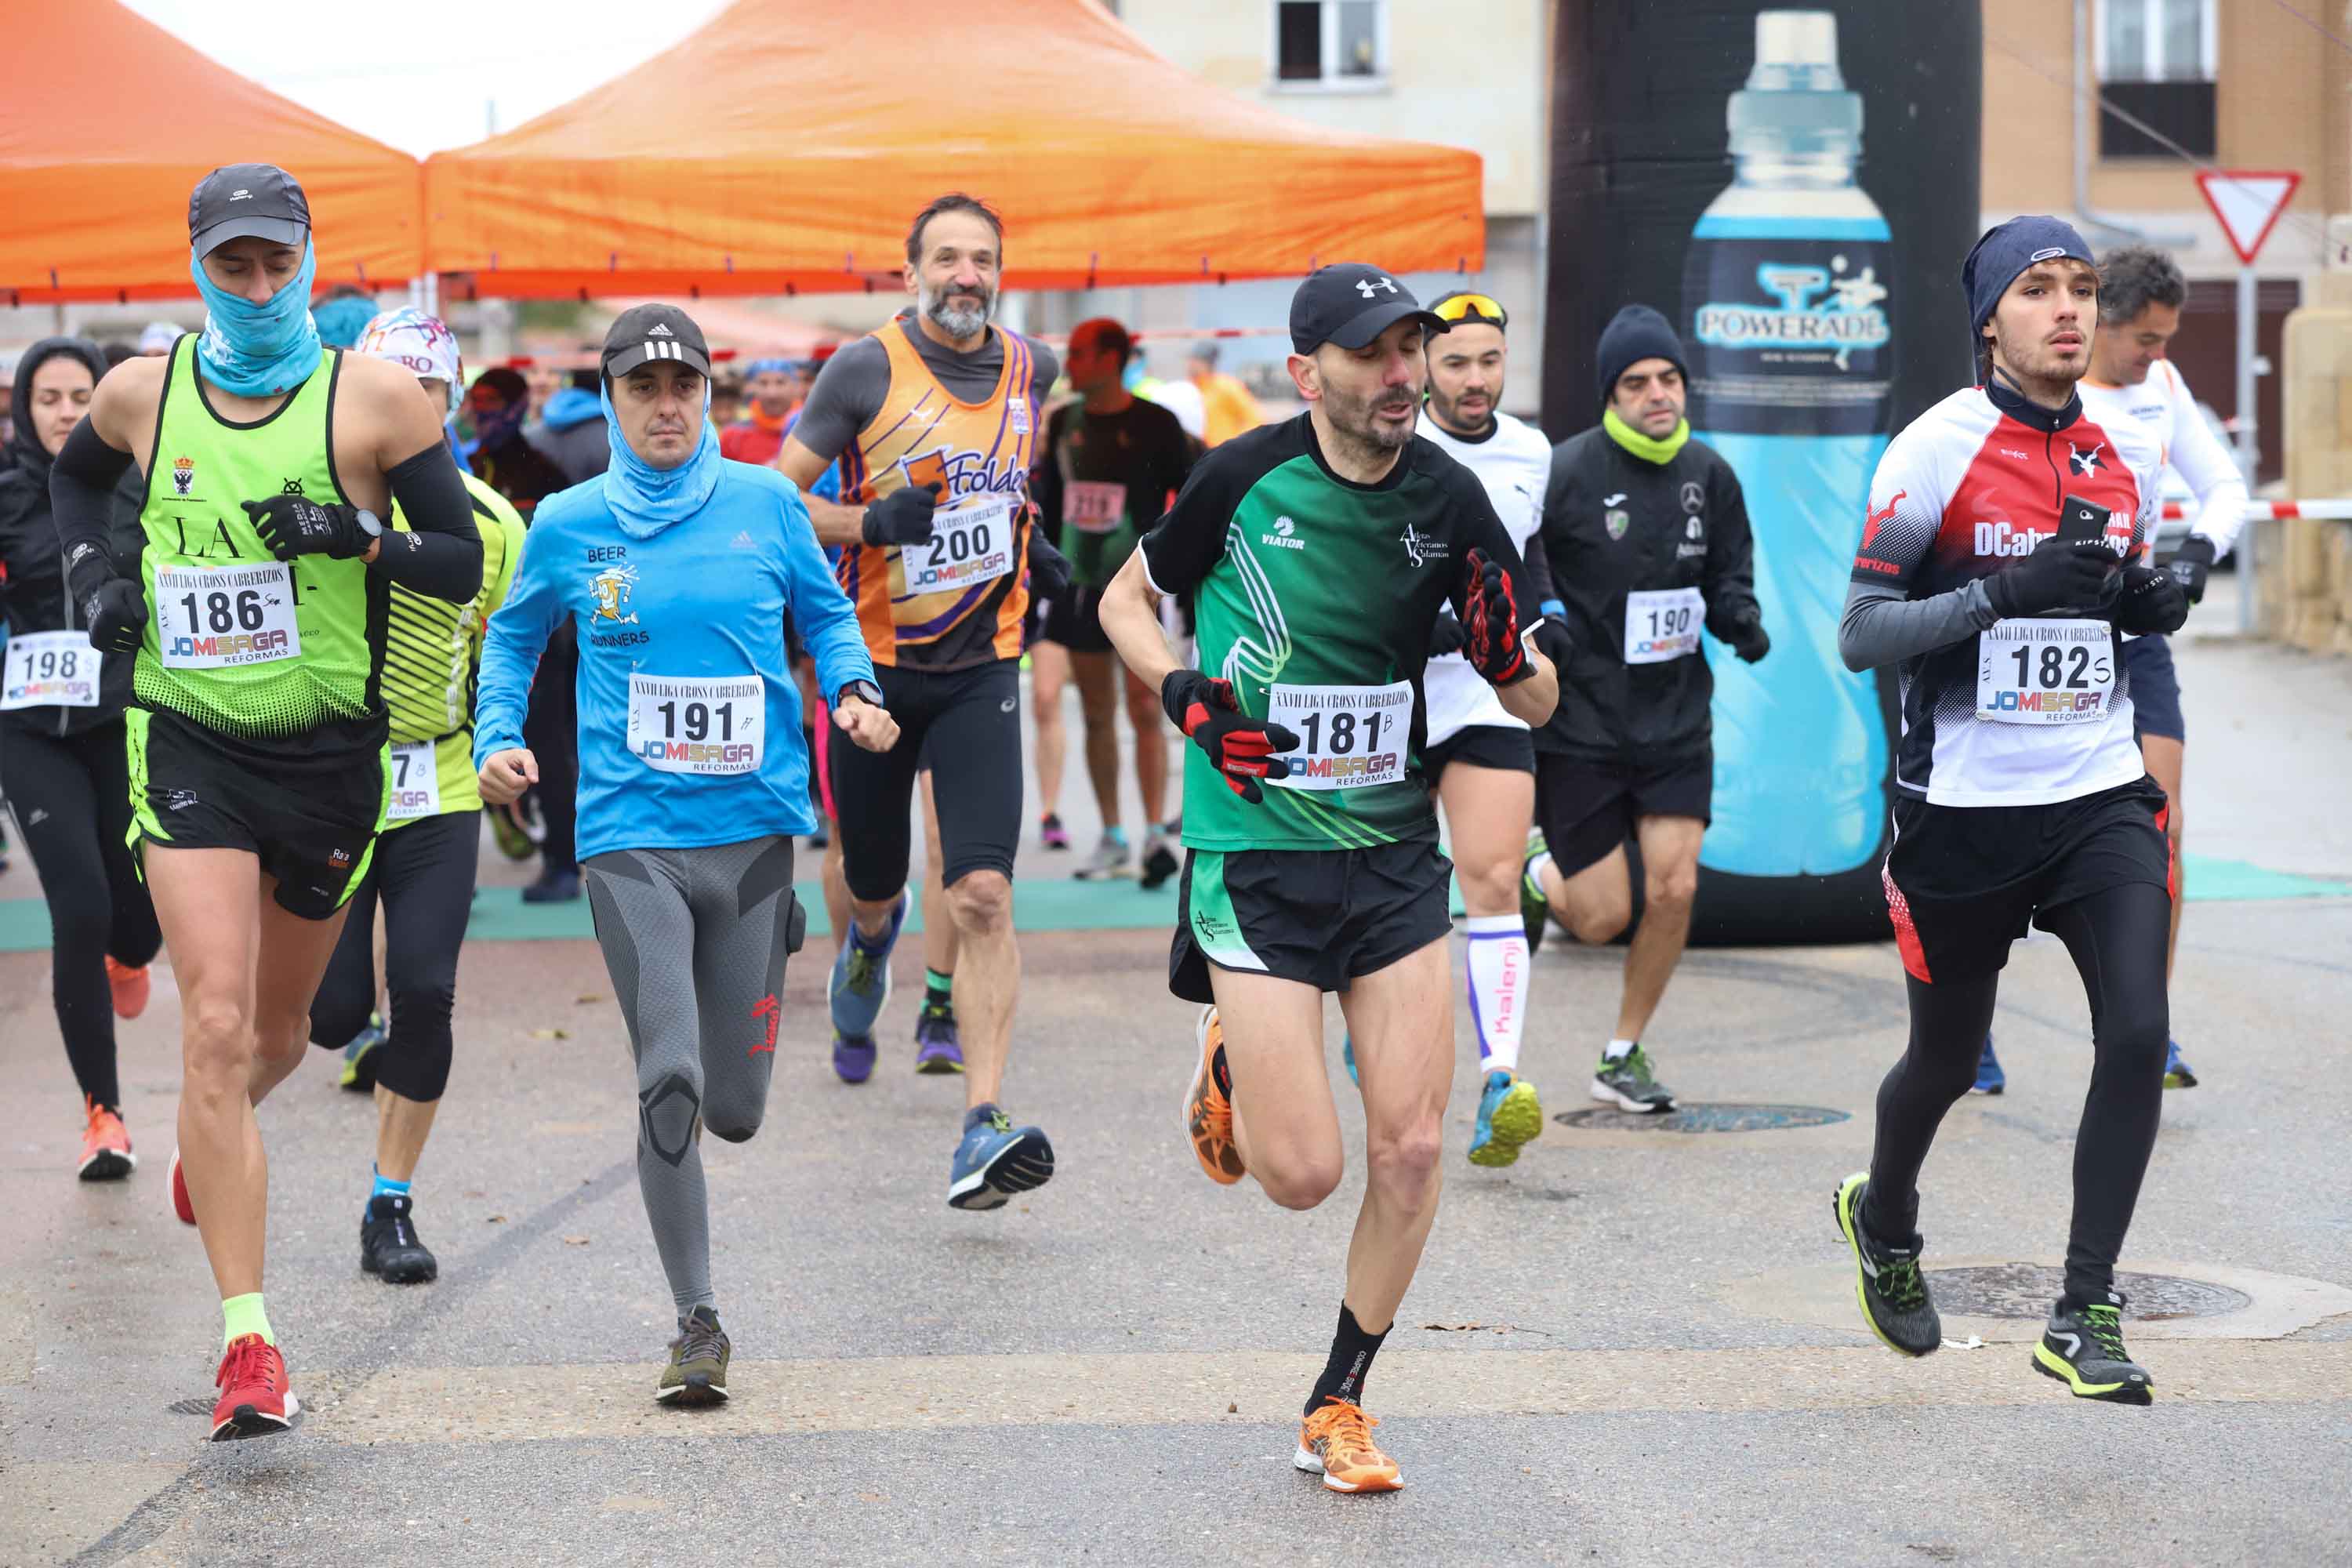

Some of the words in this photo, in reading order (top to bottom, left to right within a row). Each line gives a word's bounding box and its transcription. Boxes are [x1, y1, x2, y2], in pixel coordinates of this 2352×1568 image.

[1700, 313, 1882, 340] POWERADE
[292, 503, 309, 535] MEDIA
[928, 524, 990, 567] 200
[1262, 534, 1305, 550] VIATOR
[588, 546, 626, 563] BEER
[198, 572, 227, 589] CROSS
[227, 568, 285, 587] CABRERIZOS
[181, 590, 264, 634] 186
[1646, 607, 1691, 637] 190
[169, 629, 289, 657] JOMISAGA
[590, 630, 650, 647] RUNNERS
[2014, 626, 2034, 641] LIGA
[2036, 626, 2063, 641] CROSS
[24, 650, 78, 681] 198
[224, 649, 289, 665] REFORMAS
[2011, 644, 2090, 689] 182
[659, 683, 678, 698] LIGA
[681, 684, 707, 699] CROSS
[1305, 693, 1325, 710] LIGA
[1327, 694, 1357, 709] CROSS
[1358, 689, 1409, 709] CABRERIZOS
[1986, 691, 2103, 712] JOMISAGA
[658, 701, 732, 742] 191
[1301, 711, 1381, 755] 181
[637, 740, 754, 764] JOMISAGA
[694, 763, 753, 772] REFORMAS
[1336, 772, 1394, 786] REFORMAS
